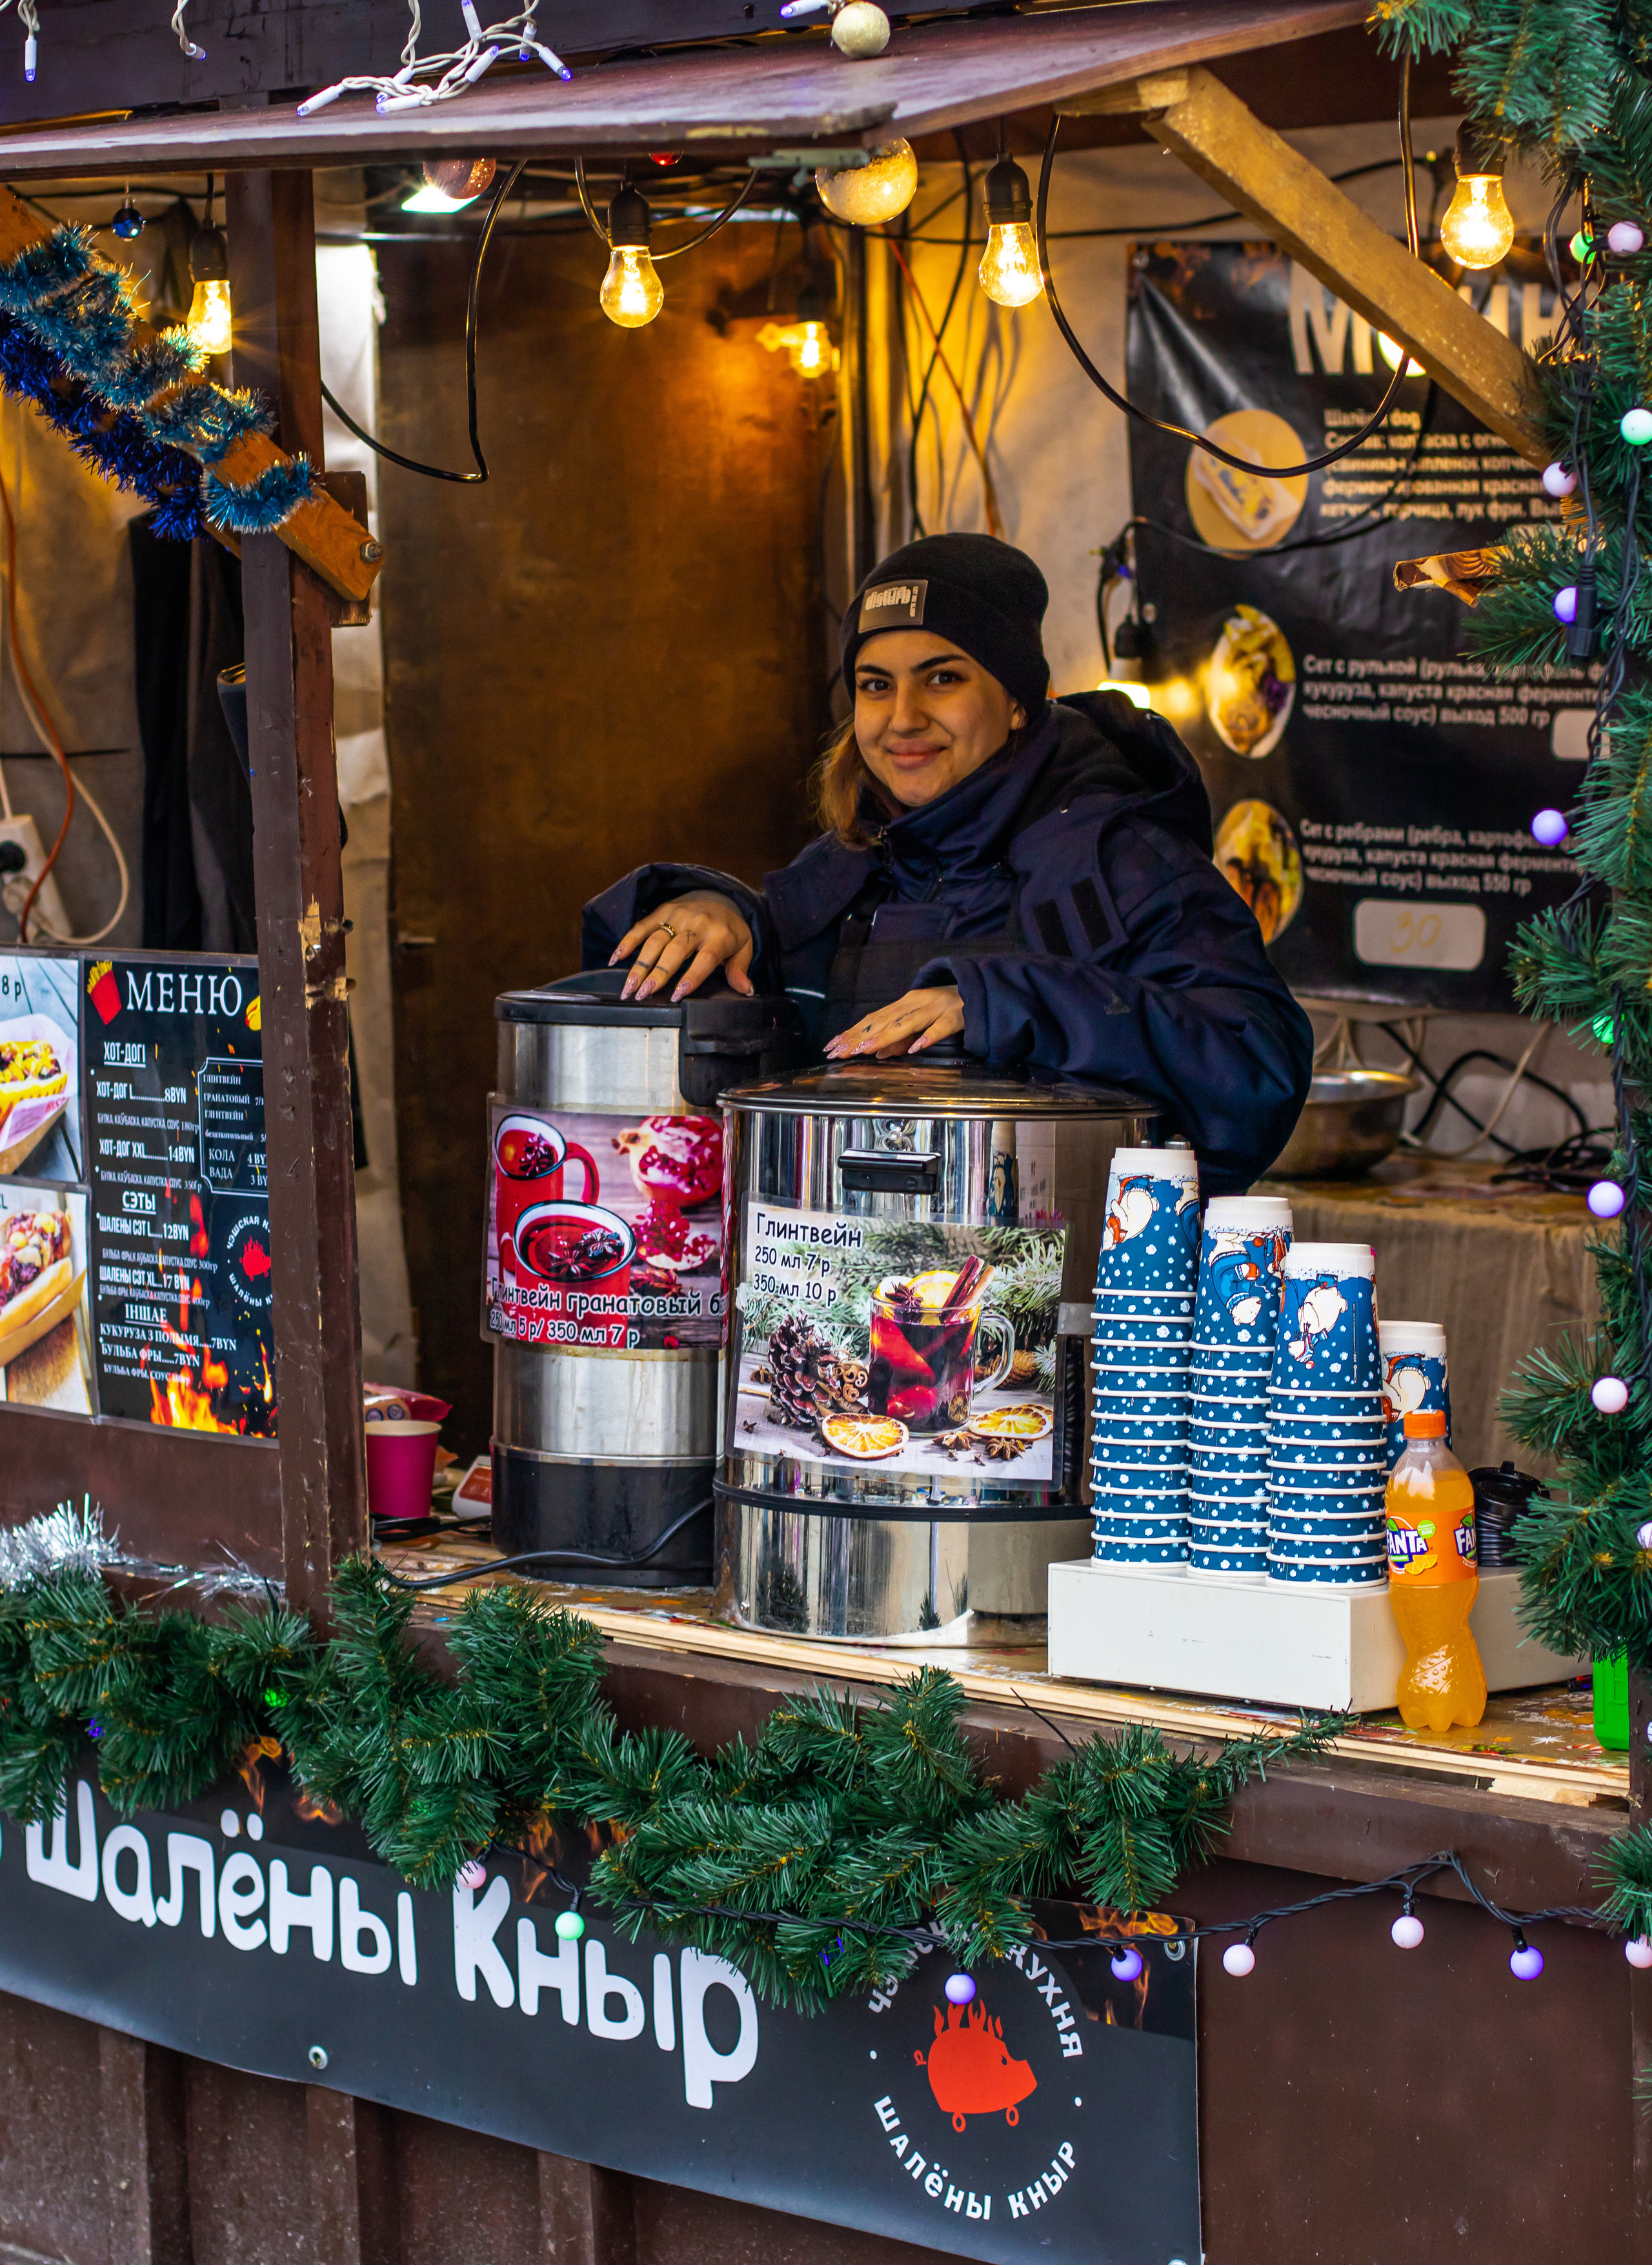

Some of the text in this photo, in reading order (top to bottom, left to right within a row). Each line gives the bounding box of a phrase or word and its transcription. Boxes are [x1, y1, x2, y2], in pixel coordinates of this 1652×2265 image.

[1389, 408, 1421, 430] dog
[1388, 432, 1457, 449] коласка
[1460, 434, 1471, 449] с
[1335, 659, 1345, 674] с
[126, 970, 242, 1016] МЕНЮ
[104, 1041, 146, 1063] ХОТ-ДОГІ
[96, 1081, 128, 1100] ХОТ-ДОГ
[203, 1092, 250, 1104] ГРАНАТОВЫЙ
[99, 1139, 130, 1158] ХОТ-ДОГ
[209, 1148, 267, 1165] КОЛА 4 BY
[210, 1167, 233, 1180] ВАДА
[250, 1175, 255, 1185] 3
[122, 1190, 156, 1211] СЭТЫ
[133, 1219, 146, 1235] СЭТ
[756, 1212, 863, 1248] Глинтвейн
[754, 1245, 831, 1282] 250 мл 7 р
[132, 1270, 146, 1286] СЭТ
[490, 1276, 561, 1311] Глинтвейн
[567, 1291, 701, 1318] гранатовый
[753, 1273, 837, 1307] 350 мл 10 р
[100, 1323, 146, 1342] КУКУРУЗА
[490, 1311, 503, 1329] 250
[504, 1318, 516, 1333] мл
[519, 1319, 527, 1334] 5
[547, 1322, 579, 1341] 350
[581, 1329, 607, 1344] мл
[610, 1325, 624, 1345] 7
[627, 1330, 640, 1349] р
[101, 1343, 137, 1360] БУЛЬБА
[103, 1363, 130, 1376] БУЛЬБА
[25, 1778, 760, 2109] Шалёны Кныр
[1007, 2140, 1076, 2220] КНЫР
